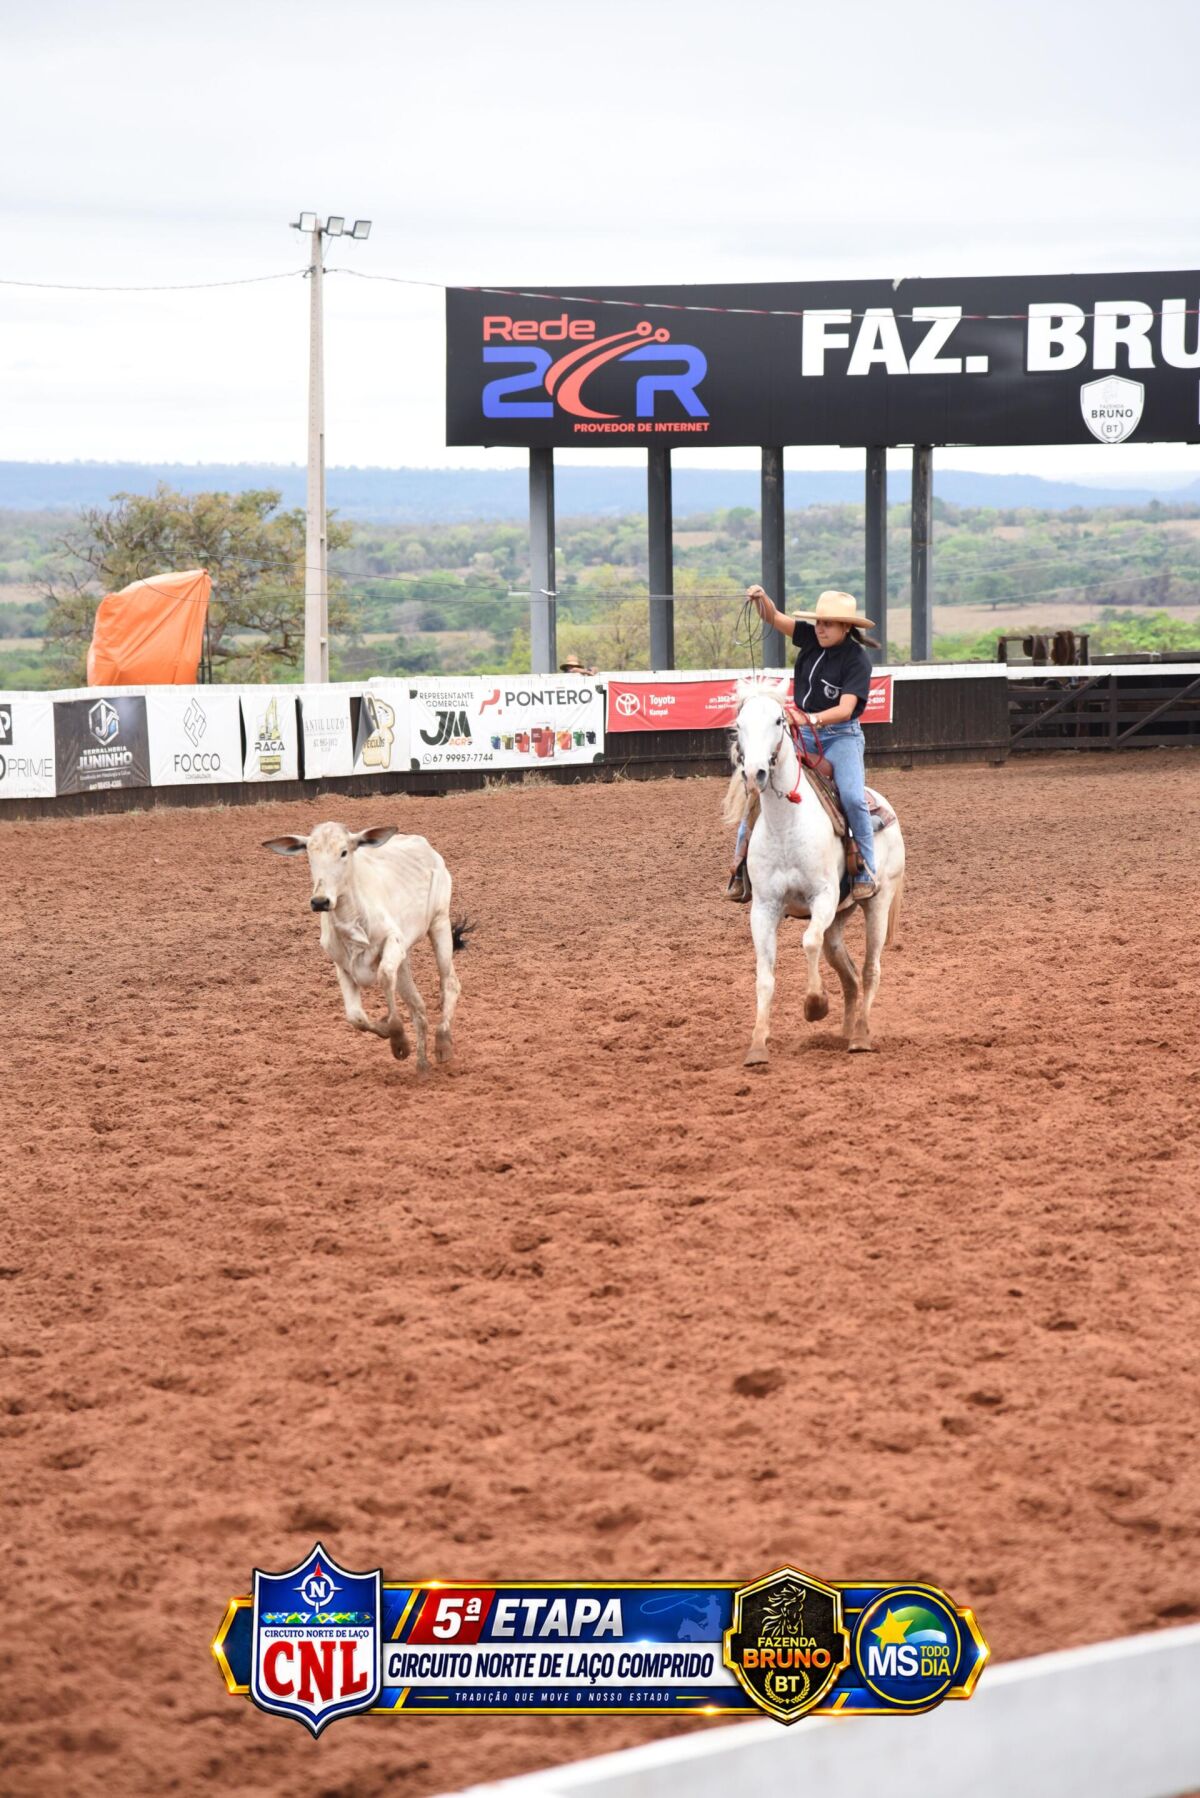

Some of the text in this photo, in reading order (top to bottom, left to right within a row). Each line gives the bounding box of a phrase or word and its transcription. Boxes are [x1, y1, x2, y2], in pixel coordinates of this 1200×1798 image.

[482, 313, 596, 342] Rede
[802, 306, 989, 377] FAZ.
[1091, 409, 1134, 419] BRUNO
[574, 422, 710, 433] PROVEDOR DE INTERNET
[1106, 424, 1119, 433] BT
[419, 692, 474, 700] REPRESENTANTE
[649, 694, 676, 707] Toyota
[426, 700, 469, 708] COMERCIAL
[77, 751, 133, 769] JUNINHO
[174, 753, 221, 772] FOCCO
[432, 753, 494, 763] 67 99957-7744
